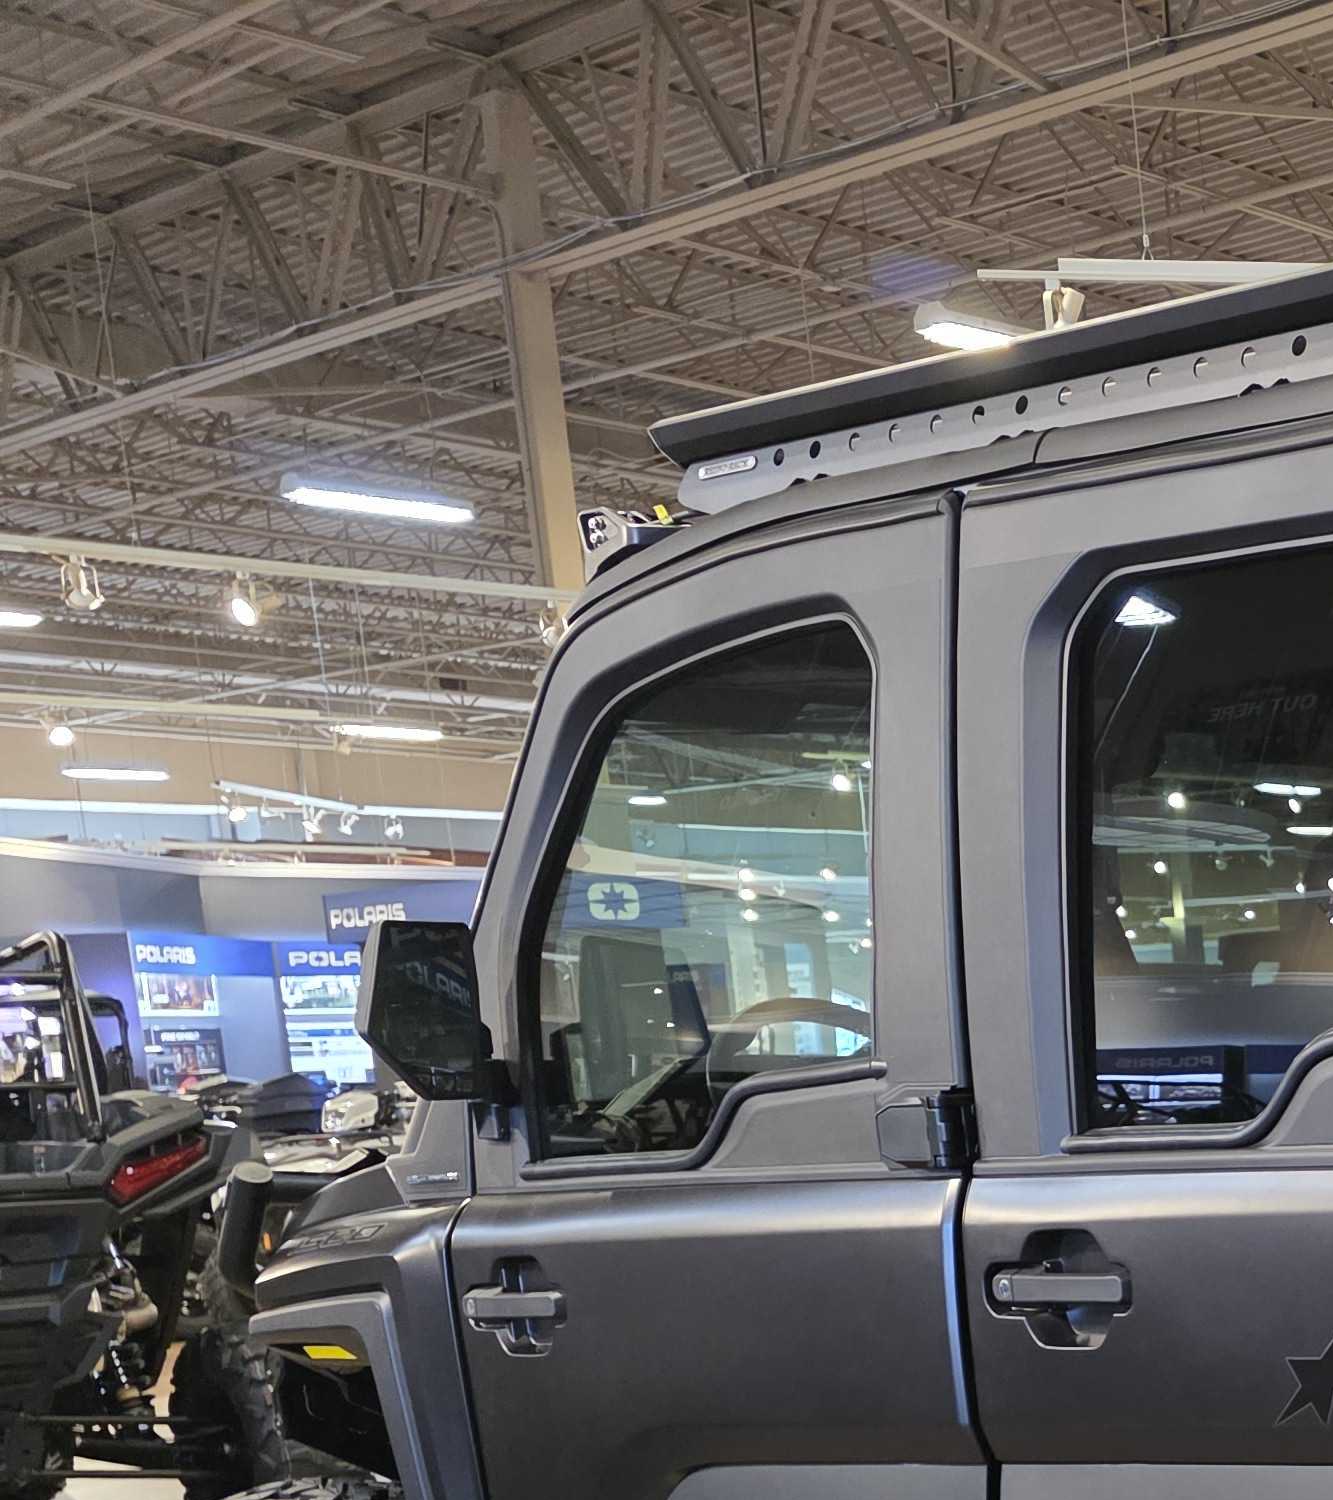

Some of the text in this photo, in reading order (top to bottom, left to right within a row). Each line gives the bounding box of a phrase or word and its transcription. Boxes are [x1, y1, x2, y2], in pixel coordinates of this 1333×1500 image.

[330, 903, 406, 929] POLARIS
[135, 944, 196, 965] POLARIS
[288, 950, 361, 967] POLA
